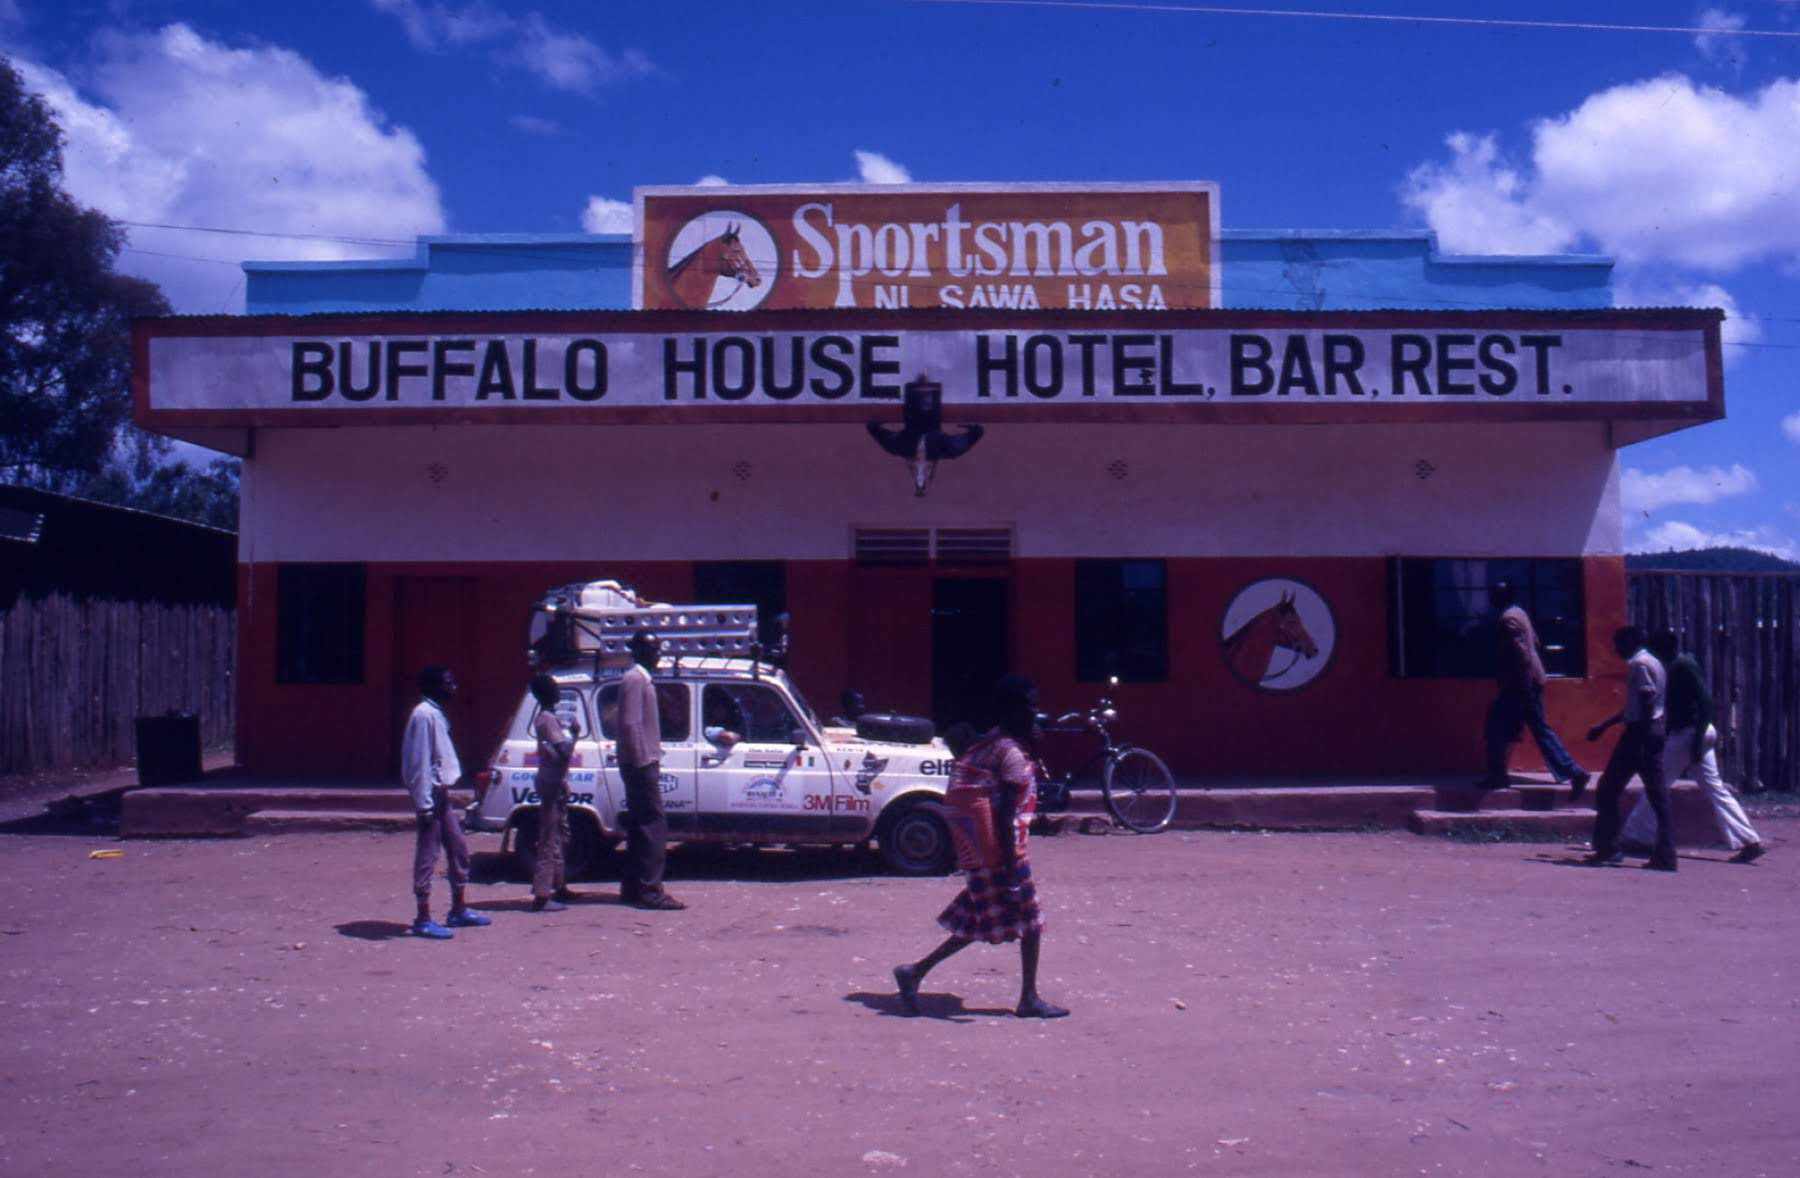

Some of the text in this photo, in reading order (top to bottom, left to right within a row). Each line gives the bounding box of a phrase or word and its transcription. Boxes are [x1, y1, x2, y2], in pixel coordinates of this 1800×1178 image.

[792, 202, 1168, 307] Sportsman
[874, 284, 1167, 310] NI SAWA HASA
[291, 334, 1572, 402] BUFFALO HOUSE HOTEL, BAR, REST.
[919, 758, 954, 776] elf
[803, 794, 870, 810] 3M Film
